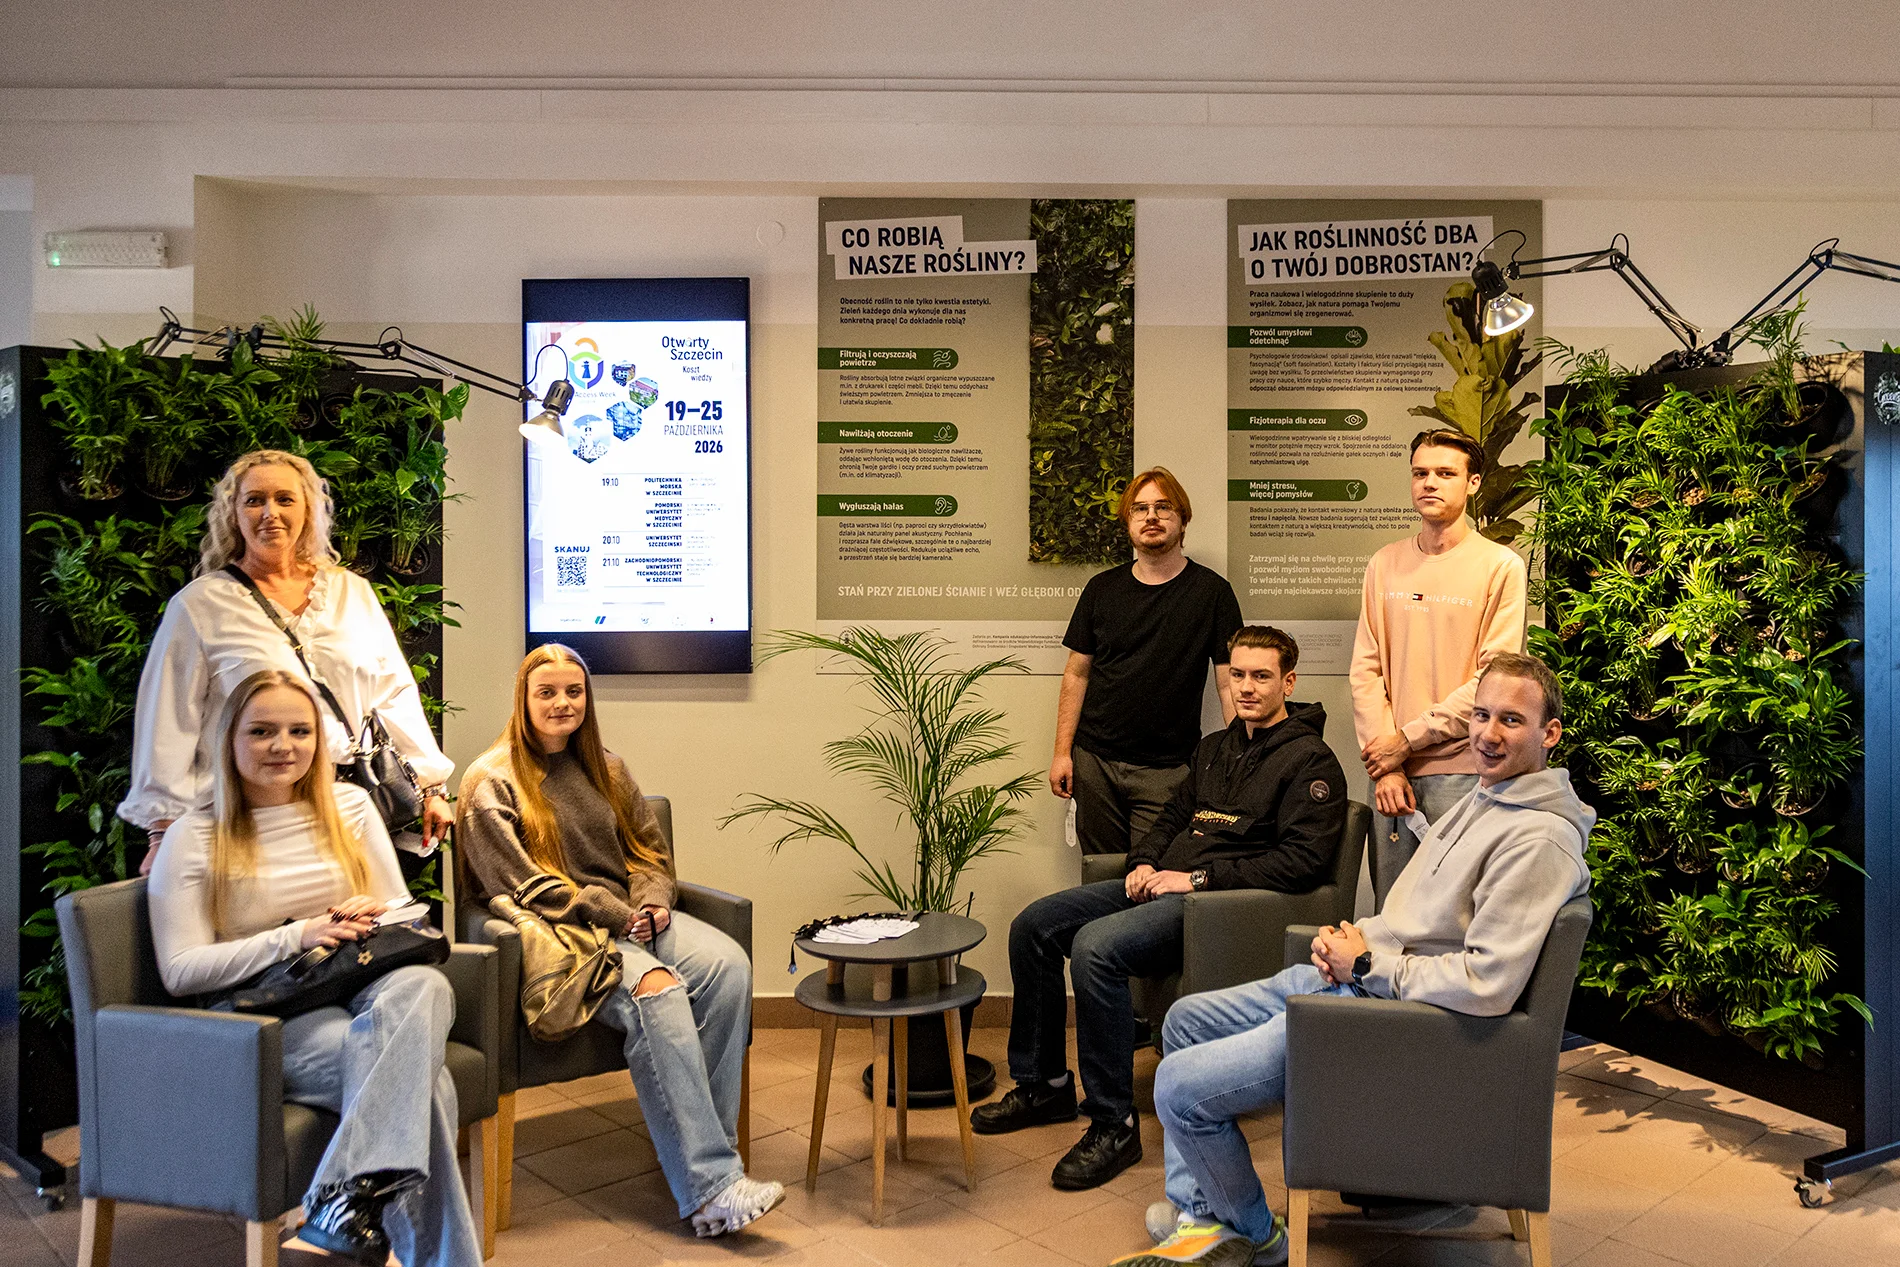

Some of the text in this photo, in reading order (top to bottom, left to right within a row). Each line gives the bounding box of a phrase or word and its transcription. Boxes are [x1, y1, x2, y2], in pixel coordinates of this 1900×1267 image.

[842, 226, 944, 249] CO ROBIĄ
[1250, 220, 1478, 251] JAK ROŚLINNOŚĆ DBA
[850, 247, 1026, 275] NASZE ROŚLINY?
[1251, 252, 1474, 279] O TWÓJ DOBROSTAN?
[1249, 290, 1269, 298] Praca
[1305, 290, 1354, 299] wielogodzinne
[1355, 290, 1388, 299] skupienie
[1398, 291, 1414, 299] duży
[840, 297, 873, 305] Obecność
[874, 297, 893, 305] roślin
[903, 297, 914, 305] nie
[916, 298, 933, 306] tylko
[962, 298, 991, 306] estetyki.
[1249, 300, 1277, 308] wysiłek.
[1279, 300, 1305, 308] Zobacz,
[1305, 300, 1317, 308] jak
[1342, 301, 1369, 309] pomaga
[1370, 300, 1400, 308] Twojemu
[862, 307, 891, 316] każdego
[908, 307, 940, 316] wykonuje
[1249, 309, 1354, 318] organizmowi się zregenerować.
[840, 317, 874, 325] konkretną
[876, 317, 897, 325] pracę!
[945, 317, 966, 325] robią?
[1278, 329, 1312, 337] umysłowi
[662, 336, 710, 350] Otwarty
[1250, 337, 1290, 346] odetchnąć
[670, 348, 723, 361] Szczecin
[840, 350, 867, 359] Filtrują
[873, 351, 917, 360] oczyszczają
[682, 366, 700, 374] Koszt
[691, 374, 713, 382] wiedzy
[1250, 416, 1293, 426] Fizjoterapia
[839, 429, 913, 439] Nawilżają otoczenie
[695, 440, 723, 453] 2026
[602, 478, 618, 487] 19.10
[1250, 482, 1297, 490] Mniej stresu,
[1250, 490, 1313, 499] więcej pomysłów
[839, 502, 904, 511] Wygłuszają hałas
[602, 535, 620, 545] 20.10
[603, 558, 619, 567] 21.10
[1249, 555, 1286, 563] Zatrzymaj
[1288, 554, 1299, 563] się
[1312, 555, 1336, 563] chwilę
[1253, 565, 1279, 574] pozwól
[1281, 565, 1310, 574] myślom
[1311, 565, 1351, 573] swobodnie
[1353, 566, 1366, 574] pob
[1249, 576, 1258, 584] To
[1259, 576, 1288, 584] właśnie
[1298, 576, 1322, 584] takich
[1324, 576, 1357, 584] chwilach
[838, 584, 864, 596] STAŃ
[867, 586, 894, 596] PRZY
[896, 586, 943, 597] ZIELONEJ
[945, 584, 986, 597] ŚCIANIE
[995, 584, 1018, 597] WEŹ
[1021, 587, 1064, 599] GŁĘBOKI
[1249, 587, 1362, 596] generuje najciekawsze skojarz
[1425, 595, 1473, 608] HILFIGER
